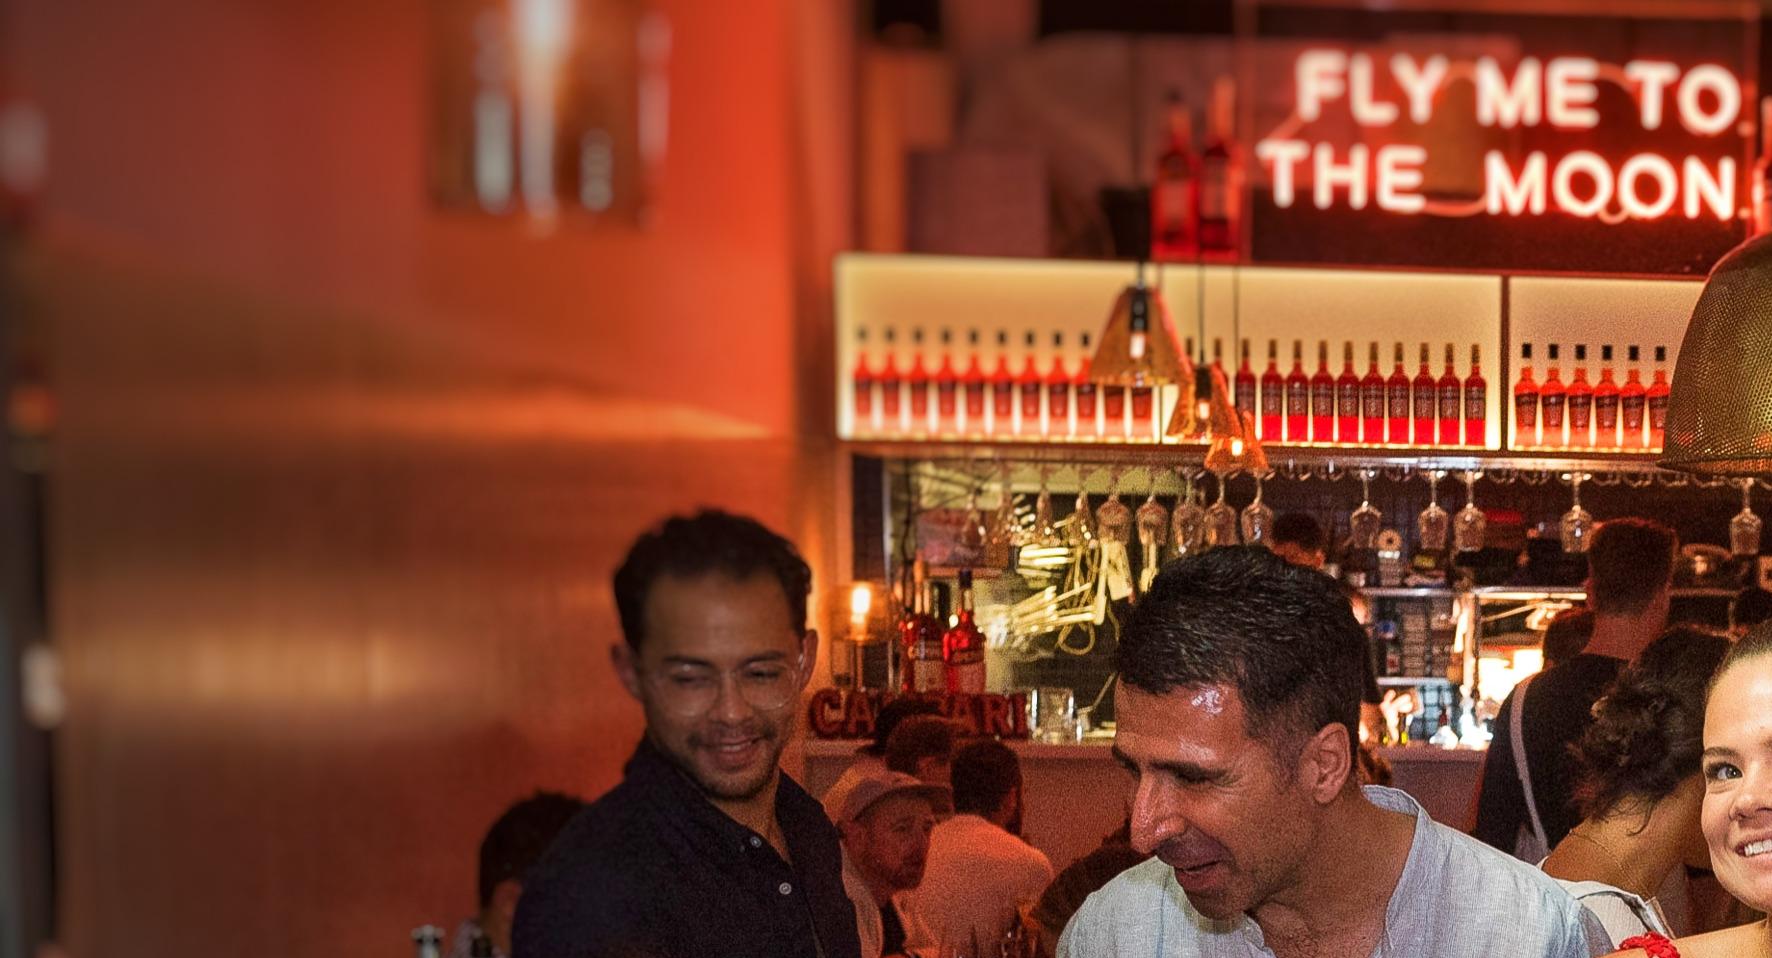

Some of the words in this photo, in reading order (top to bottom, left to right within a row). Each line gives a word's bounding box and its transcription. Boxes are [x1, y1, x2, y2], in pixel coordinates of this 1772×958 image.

[1295, 48, 1449, 125] FLY
[1475, 55, 1602, 128] ME
[1256, 138, 1428, 213] THE
[809, 688, 1029, 739] CAARI
